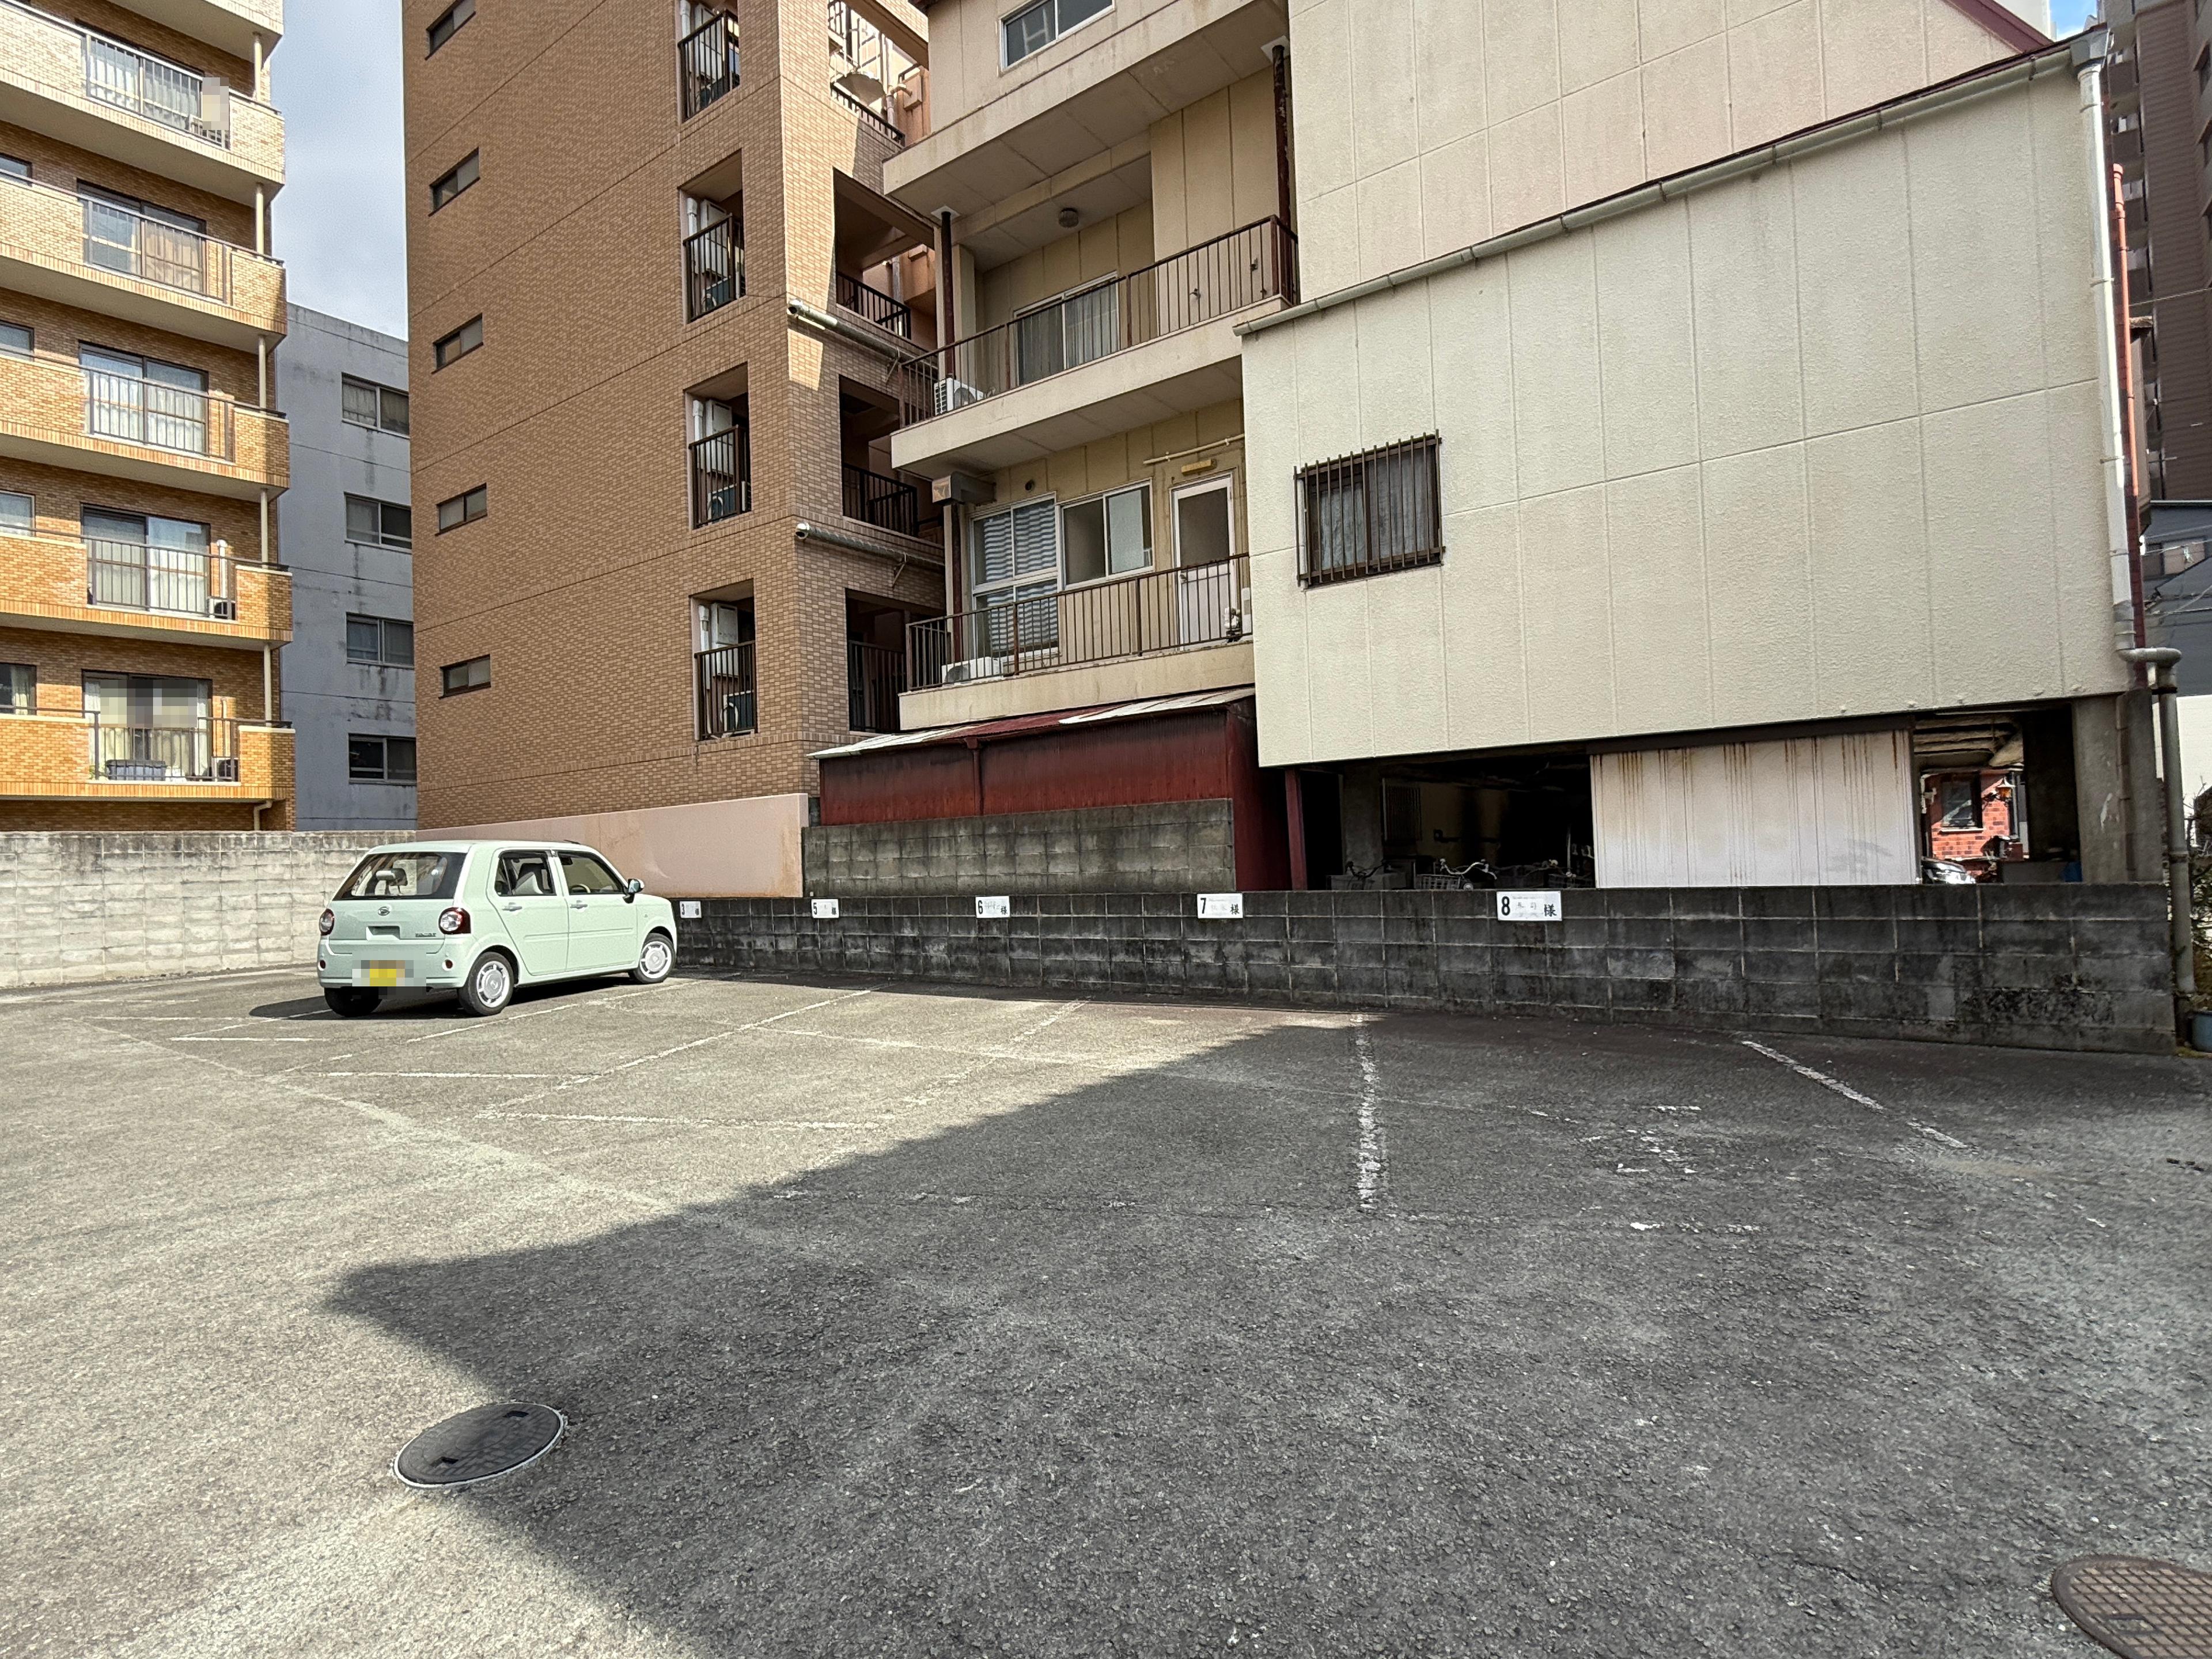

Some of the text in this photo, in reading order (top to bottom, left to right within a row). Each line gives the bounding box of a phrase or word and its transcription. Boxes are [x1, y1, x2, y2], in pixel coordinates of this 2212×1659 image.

[681, 903, 685, 915] 3
[813, 902, 817, 915] 5
[978, 900, 983, 914] 6
[1200, 897, 1207, 914] 7
[1501, 896, 1510, 916] 8
[1544, 904, 1557, 917] 様
